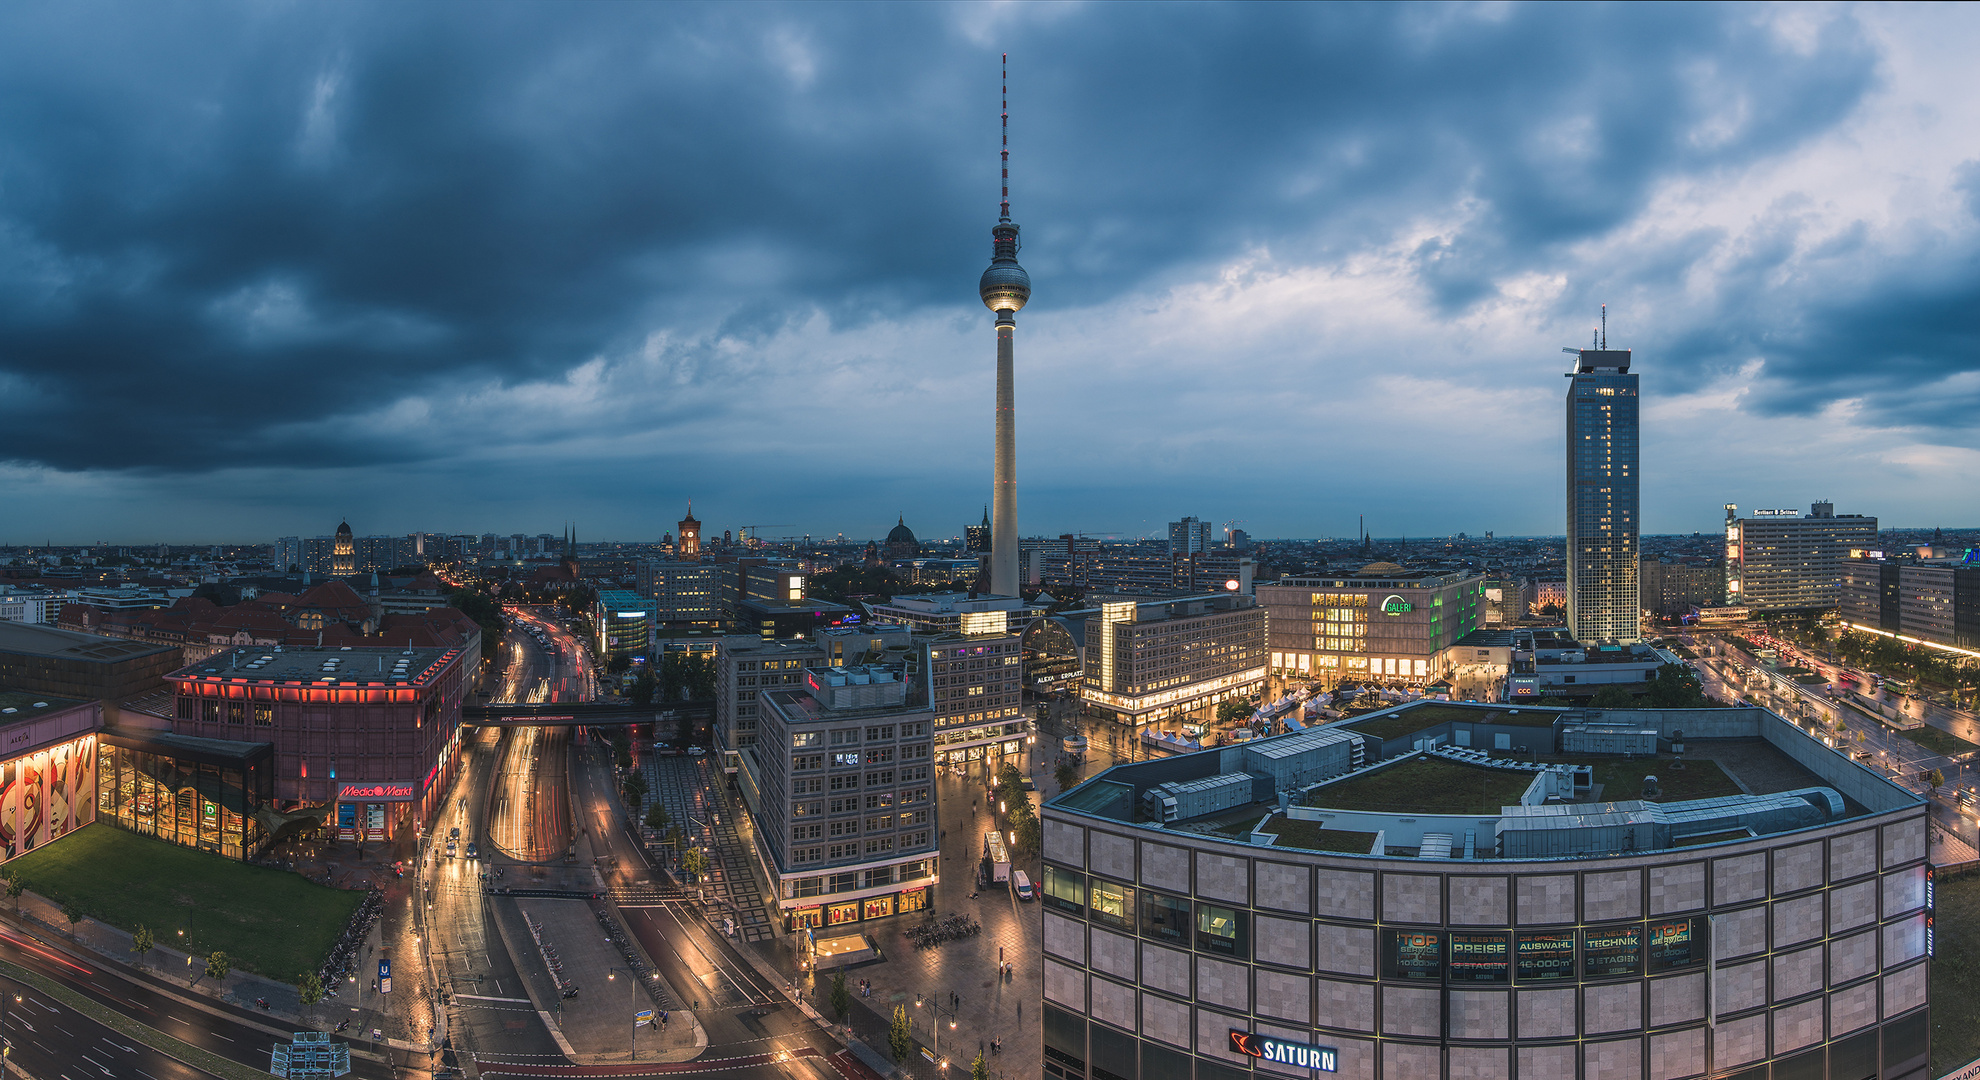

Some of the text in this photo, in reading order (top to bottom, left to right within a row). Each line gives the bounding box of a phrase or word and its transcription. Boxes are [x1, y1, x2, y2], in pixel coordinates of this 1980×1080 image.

[1161, 927, 1180, 937] SATURN
[1651, 922, 1688, 938] TOP
[1400, 934, 1438, 946] TOP
[1587, 937, 1638, 948] TECHNIK
[1651, 935, 1688, 946] SERVICE
[1453, 944, 1506, 954] PREISE
[1520, 941, 1572, 950] AUSWAHL
[1597, 955, 1639, 964] ETAGEN
[1464, 962, 1506, 970] ETAGEN
[1264, 1041, 1334, 1071] SATURN
